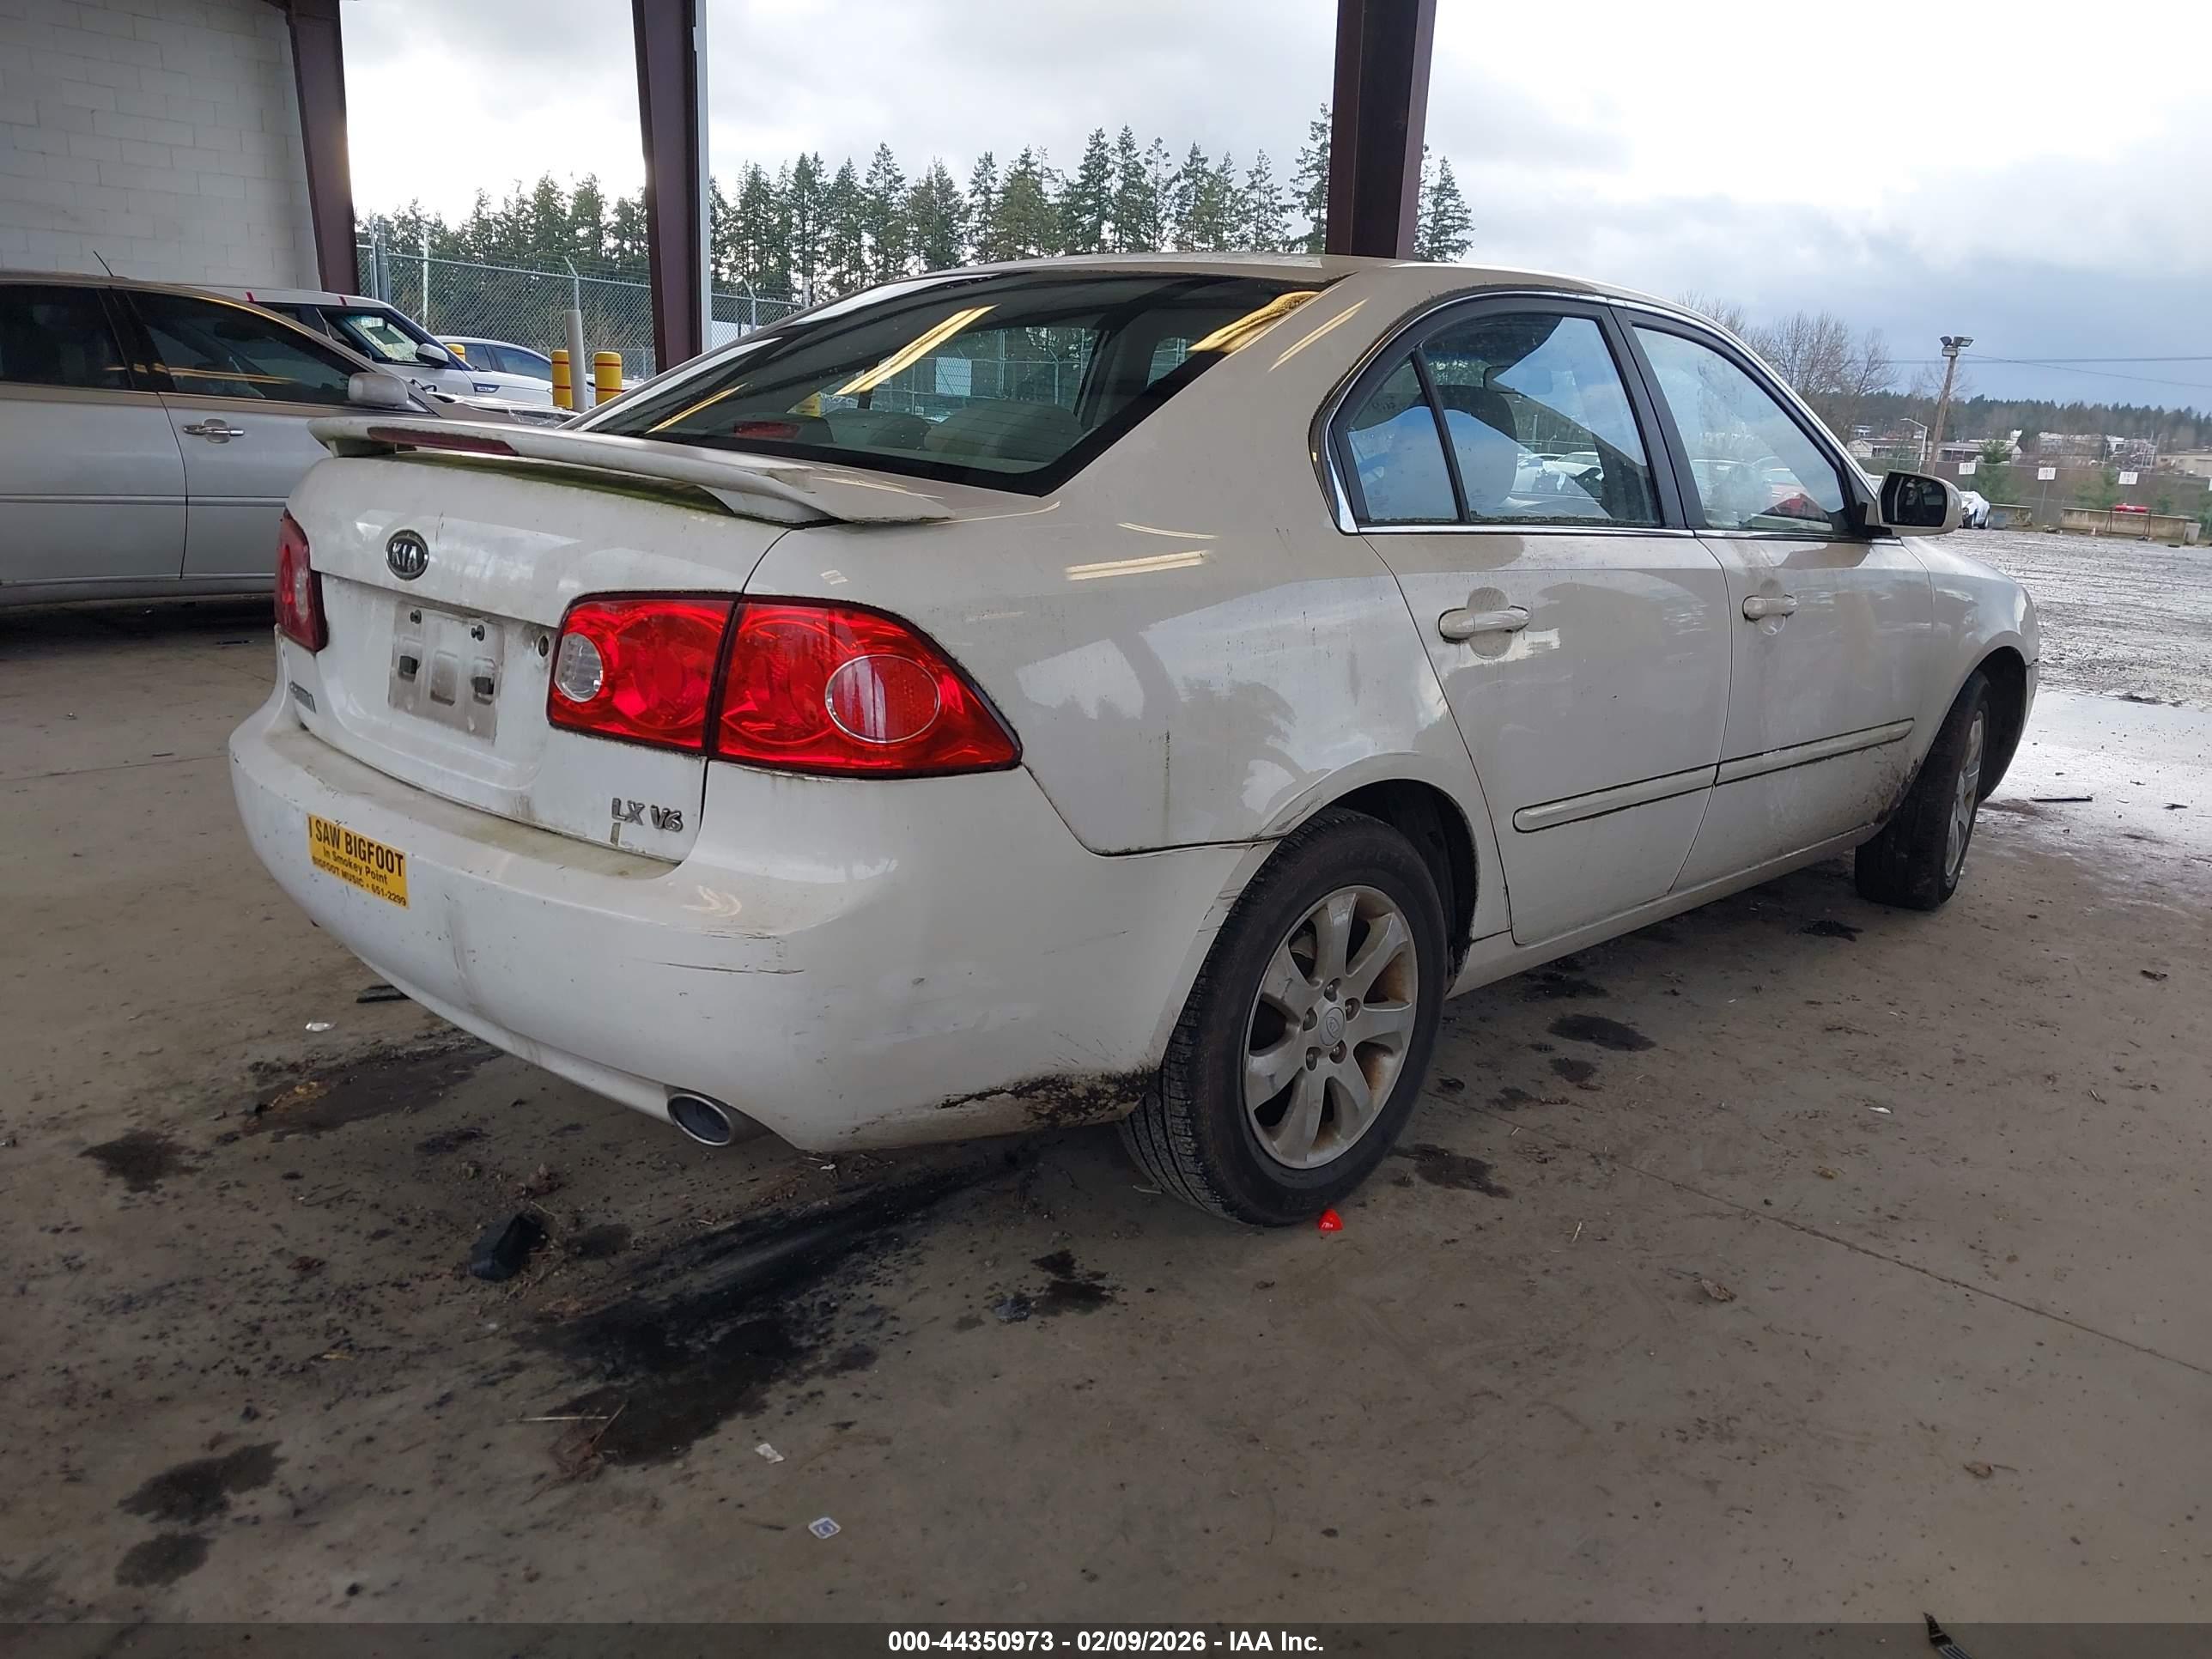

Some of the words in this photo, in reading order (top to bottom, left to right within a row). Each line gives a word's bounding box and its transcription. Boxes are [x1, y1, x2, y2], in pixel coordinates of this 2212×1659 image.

[611, 798, 646, 826] LX
[650, 805, 684, 833] V6
[308, 817, 313, 838] I
[315, 819, 340, 850] SAW
[344, 831, 404, 877] BIGFOOT
[332, 850, 362, 875] Smokey
[365, 865, 387, 885] Point
